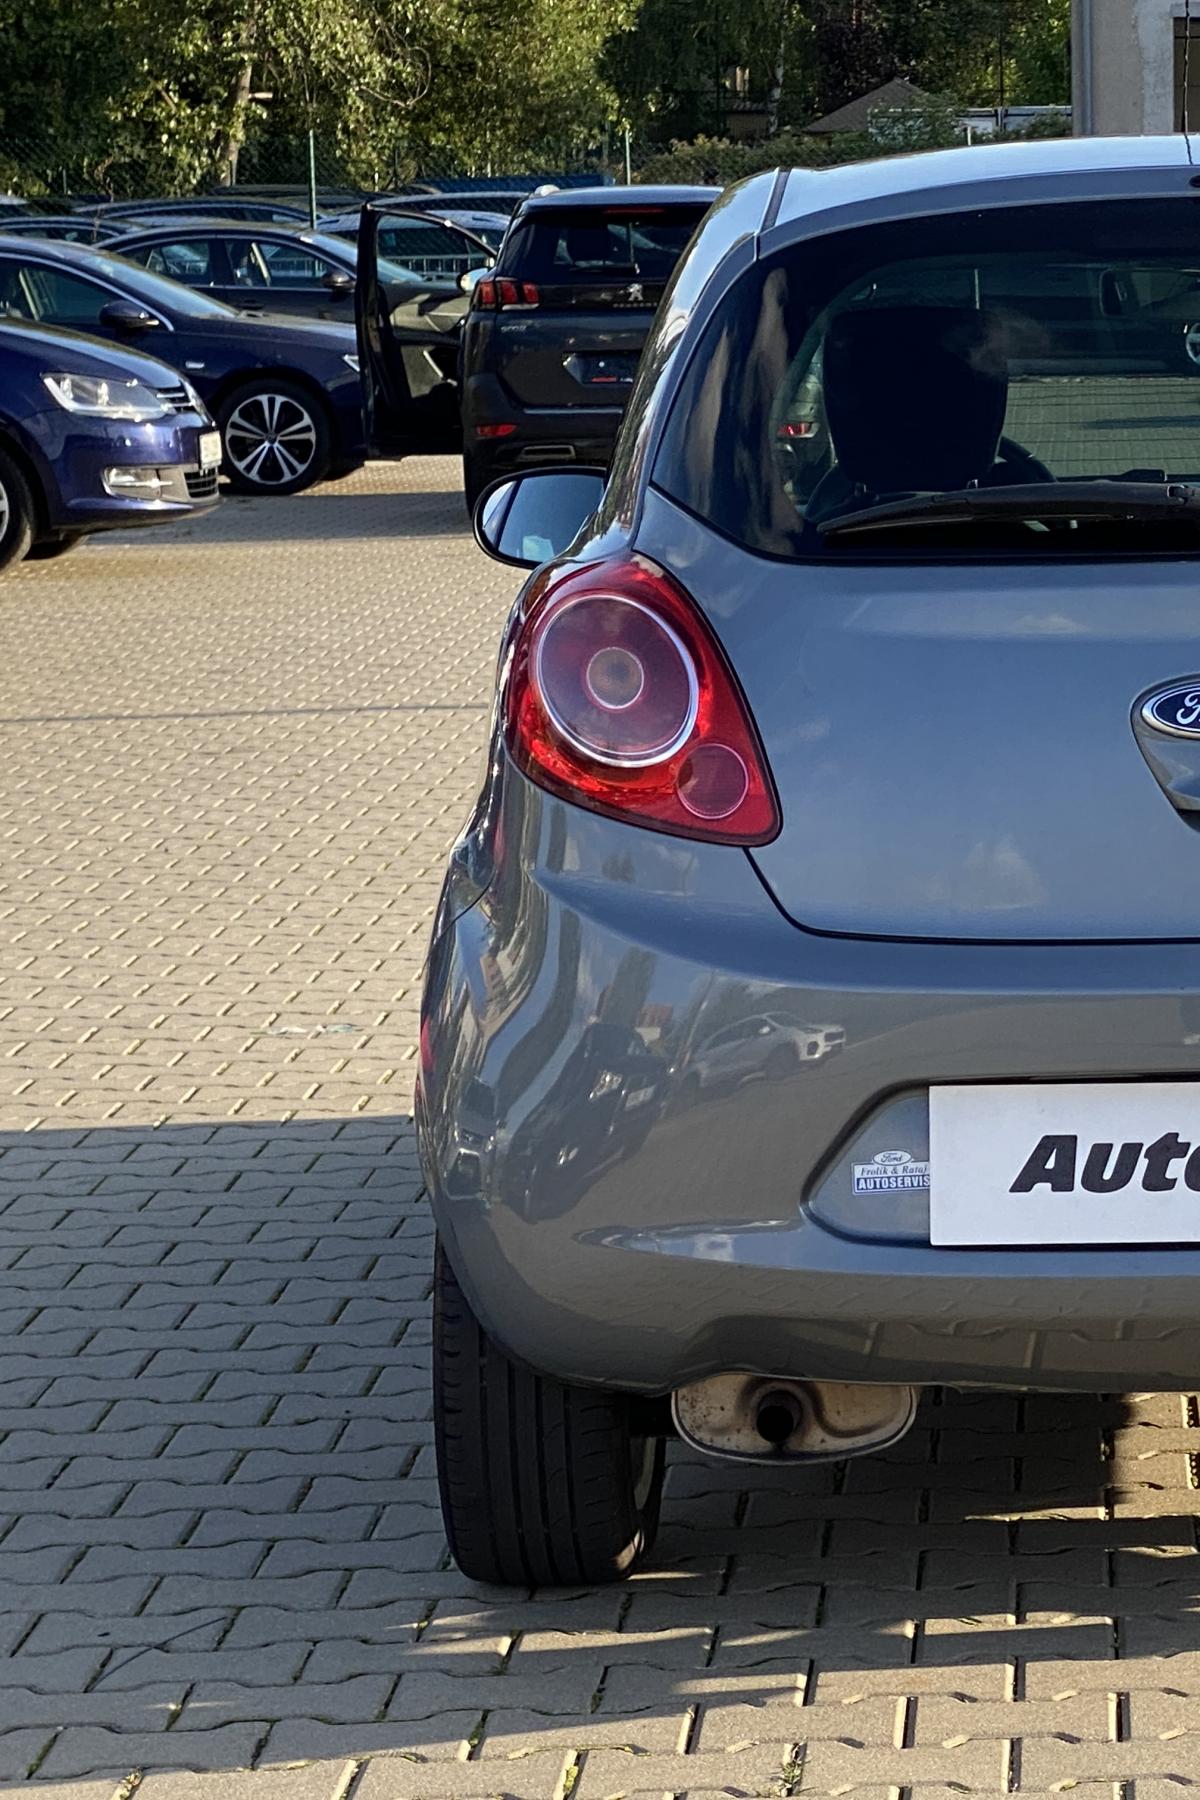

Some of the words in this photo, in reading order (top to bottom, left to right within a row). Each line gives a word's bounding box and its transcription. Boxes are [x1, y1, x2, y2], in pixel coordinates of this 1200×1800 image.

[880, 1152, 903, 1163] Ford
[890, 1166, 899, 1175] &
[858, 1175, 930, 1190] AUTOSERVIS
